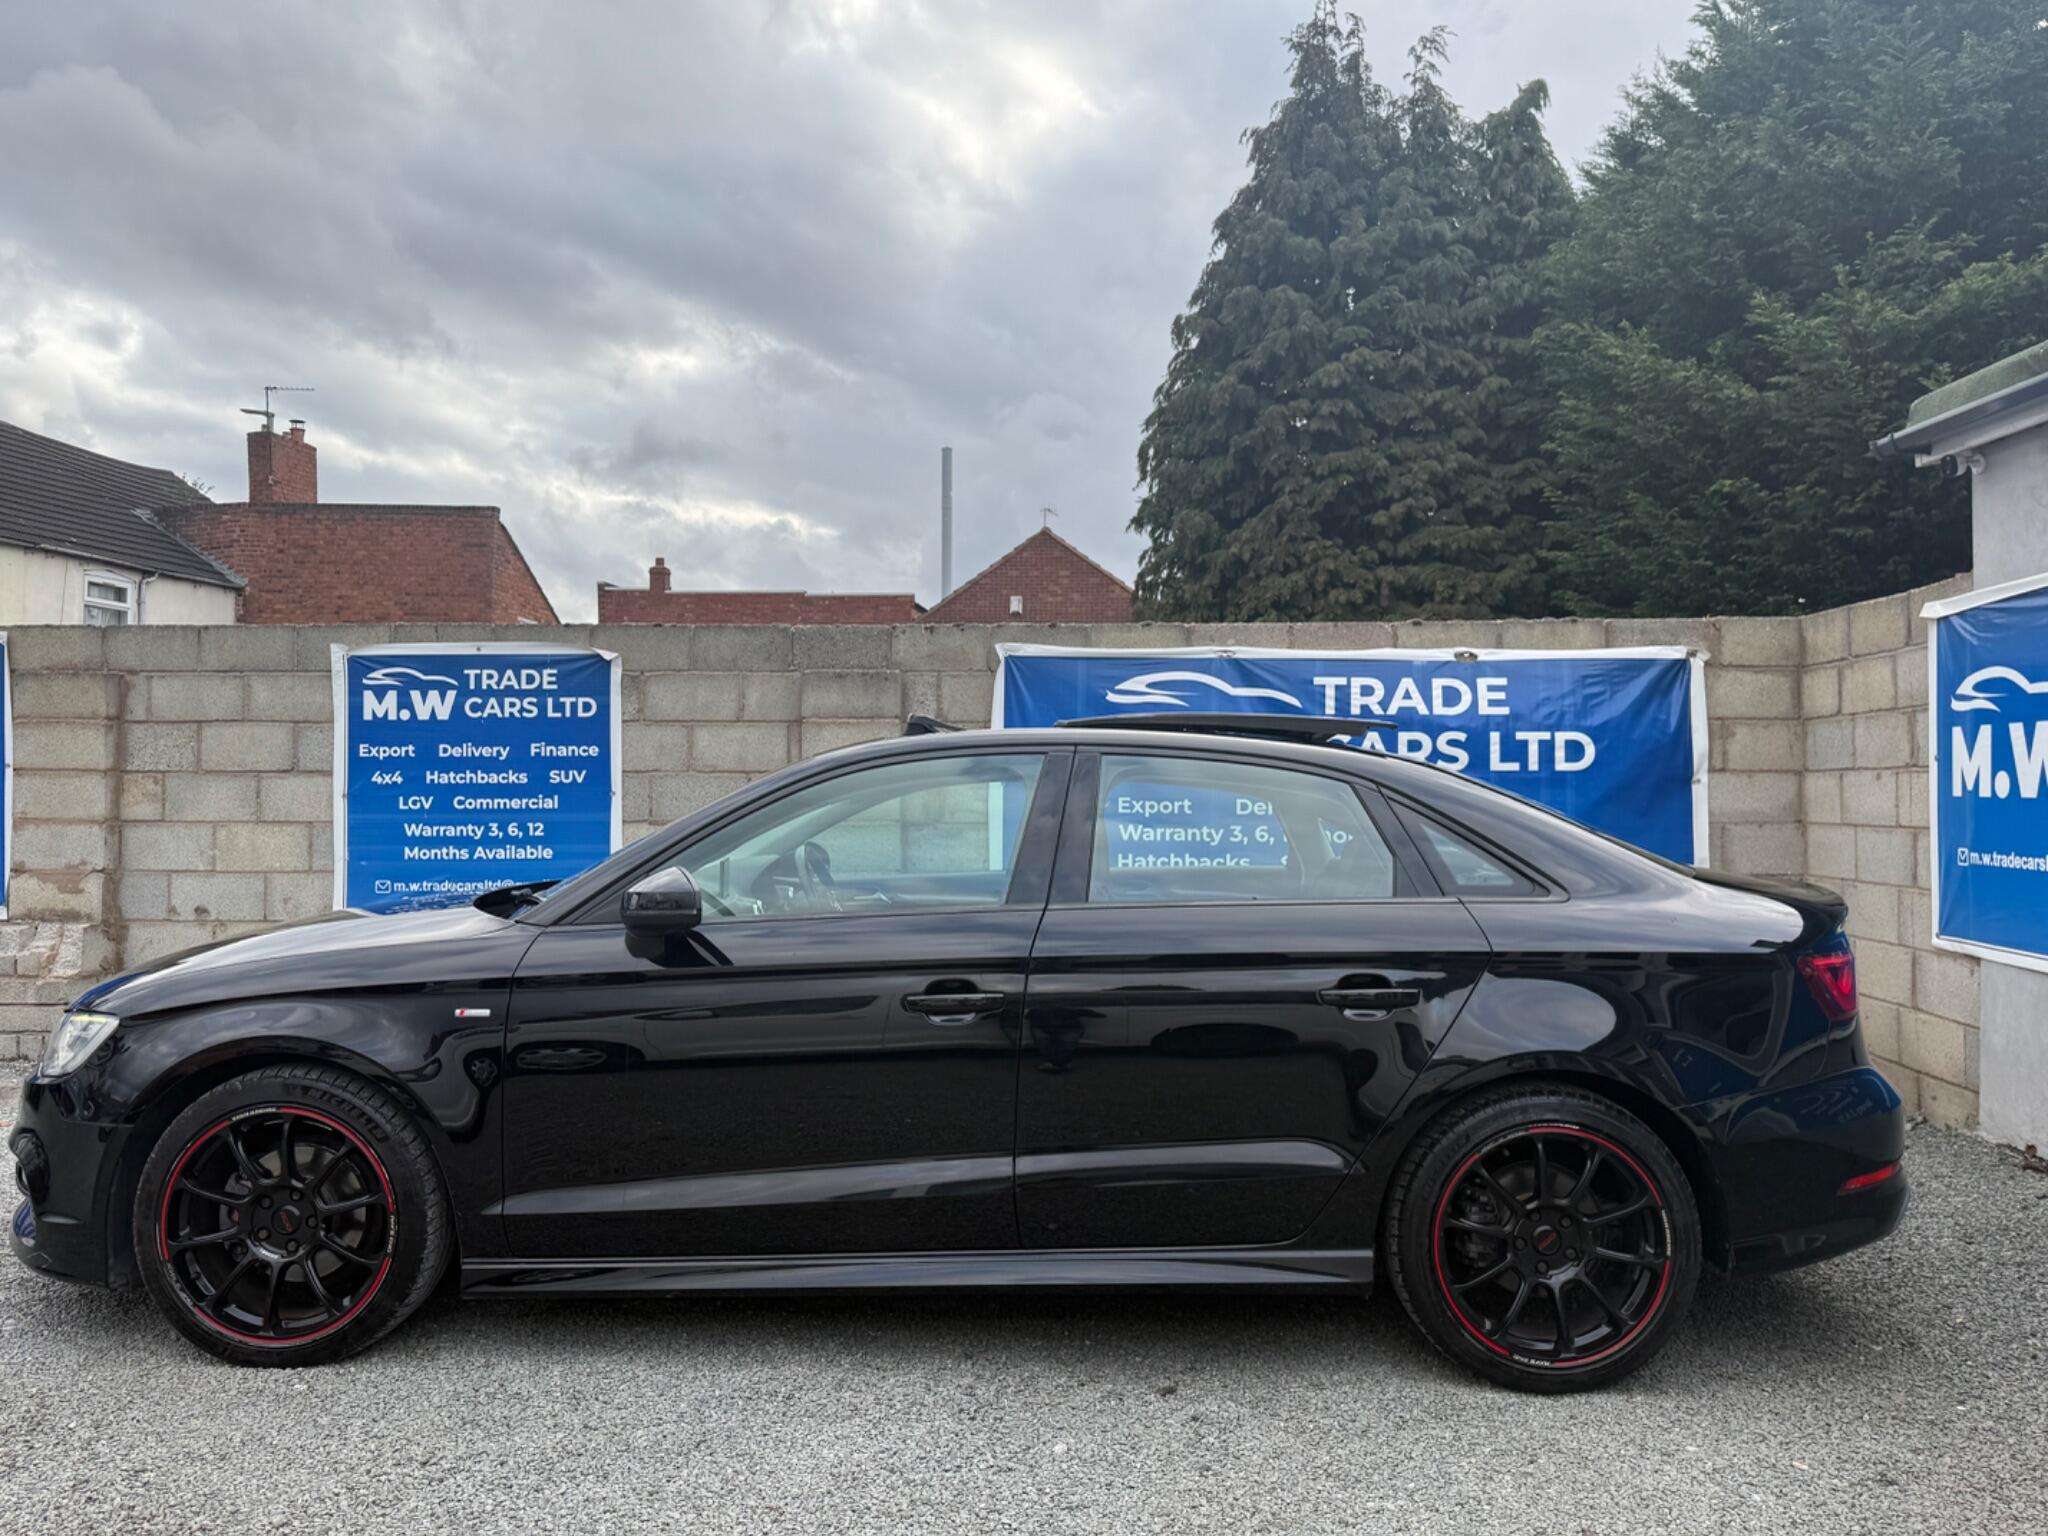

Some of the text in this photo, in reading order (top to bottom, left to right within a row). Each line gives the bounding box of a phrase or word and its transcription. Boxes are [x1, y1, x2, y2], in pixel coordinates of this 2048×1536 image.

[464, 669, 557, 690] TRADE
[363, 690, 457, 720] M.W
[1313, 677, 1510, 715] TRADE
[464, 697, 597, 718] CARS LTD
[359, 743, 599, 761] Export Delivery Finance
[1326, 731, 1596, 772] ARS LTD
[371, 770, 586, 785] 4x4 Hatchbacks SUV
[399, 795, 558, 810] LGV Commercial
[1118, 797, 1192, 817] Export
[404, 822, 544, 840] Warranty 3, 6, 12
[1119, 824, 1223, 847] Warranty
[1229, 825, 1248, 845] 3,
[1255, 825, 1274, 845] 6,
[404, 845, 553, 860] Months Available
